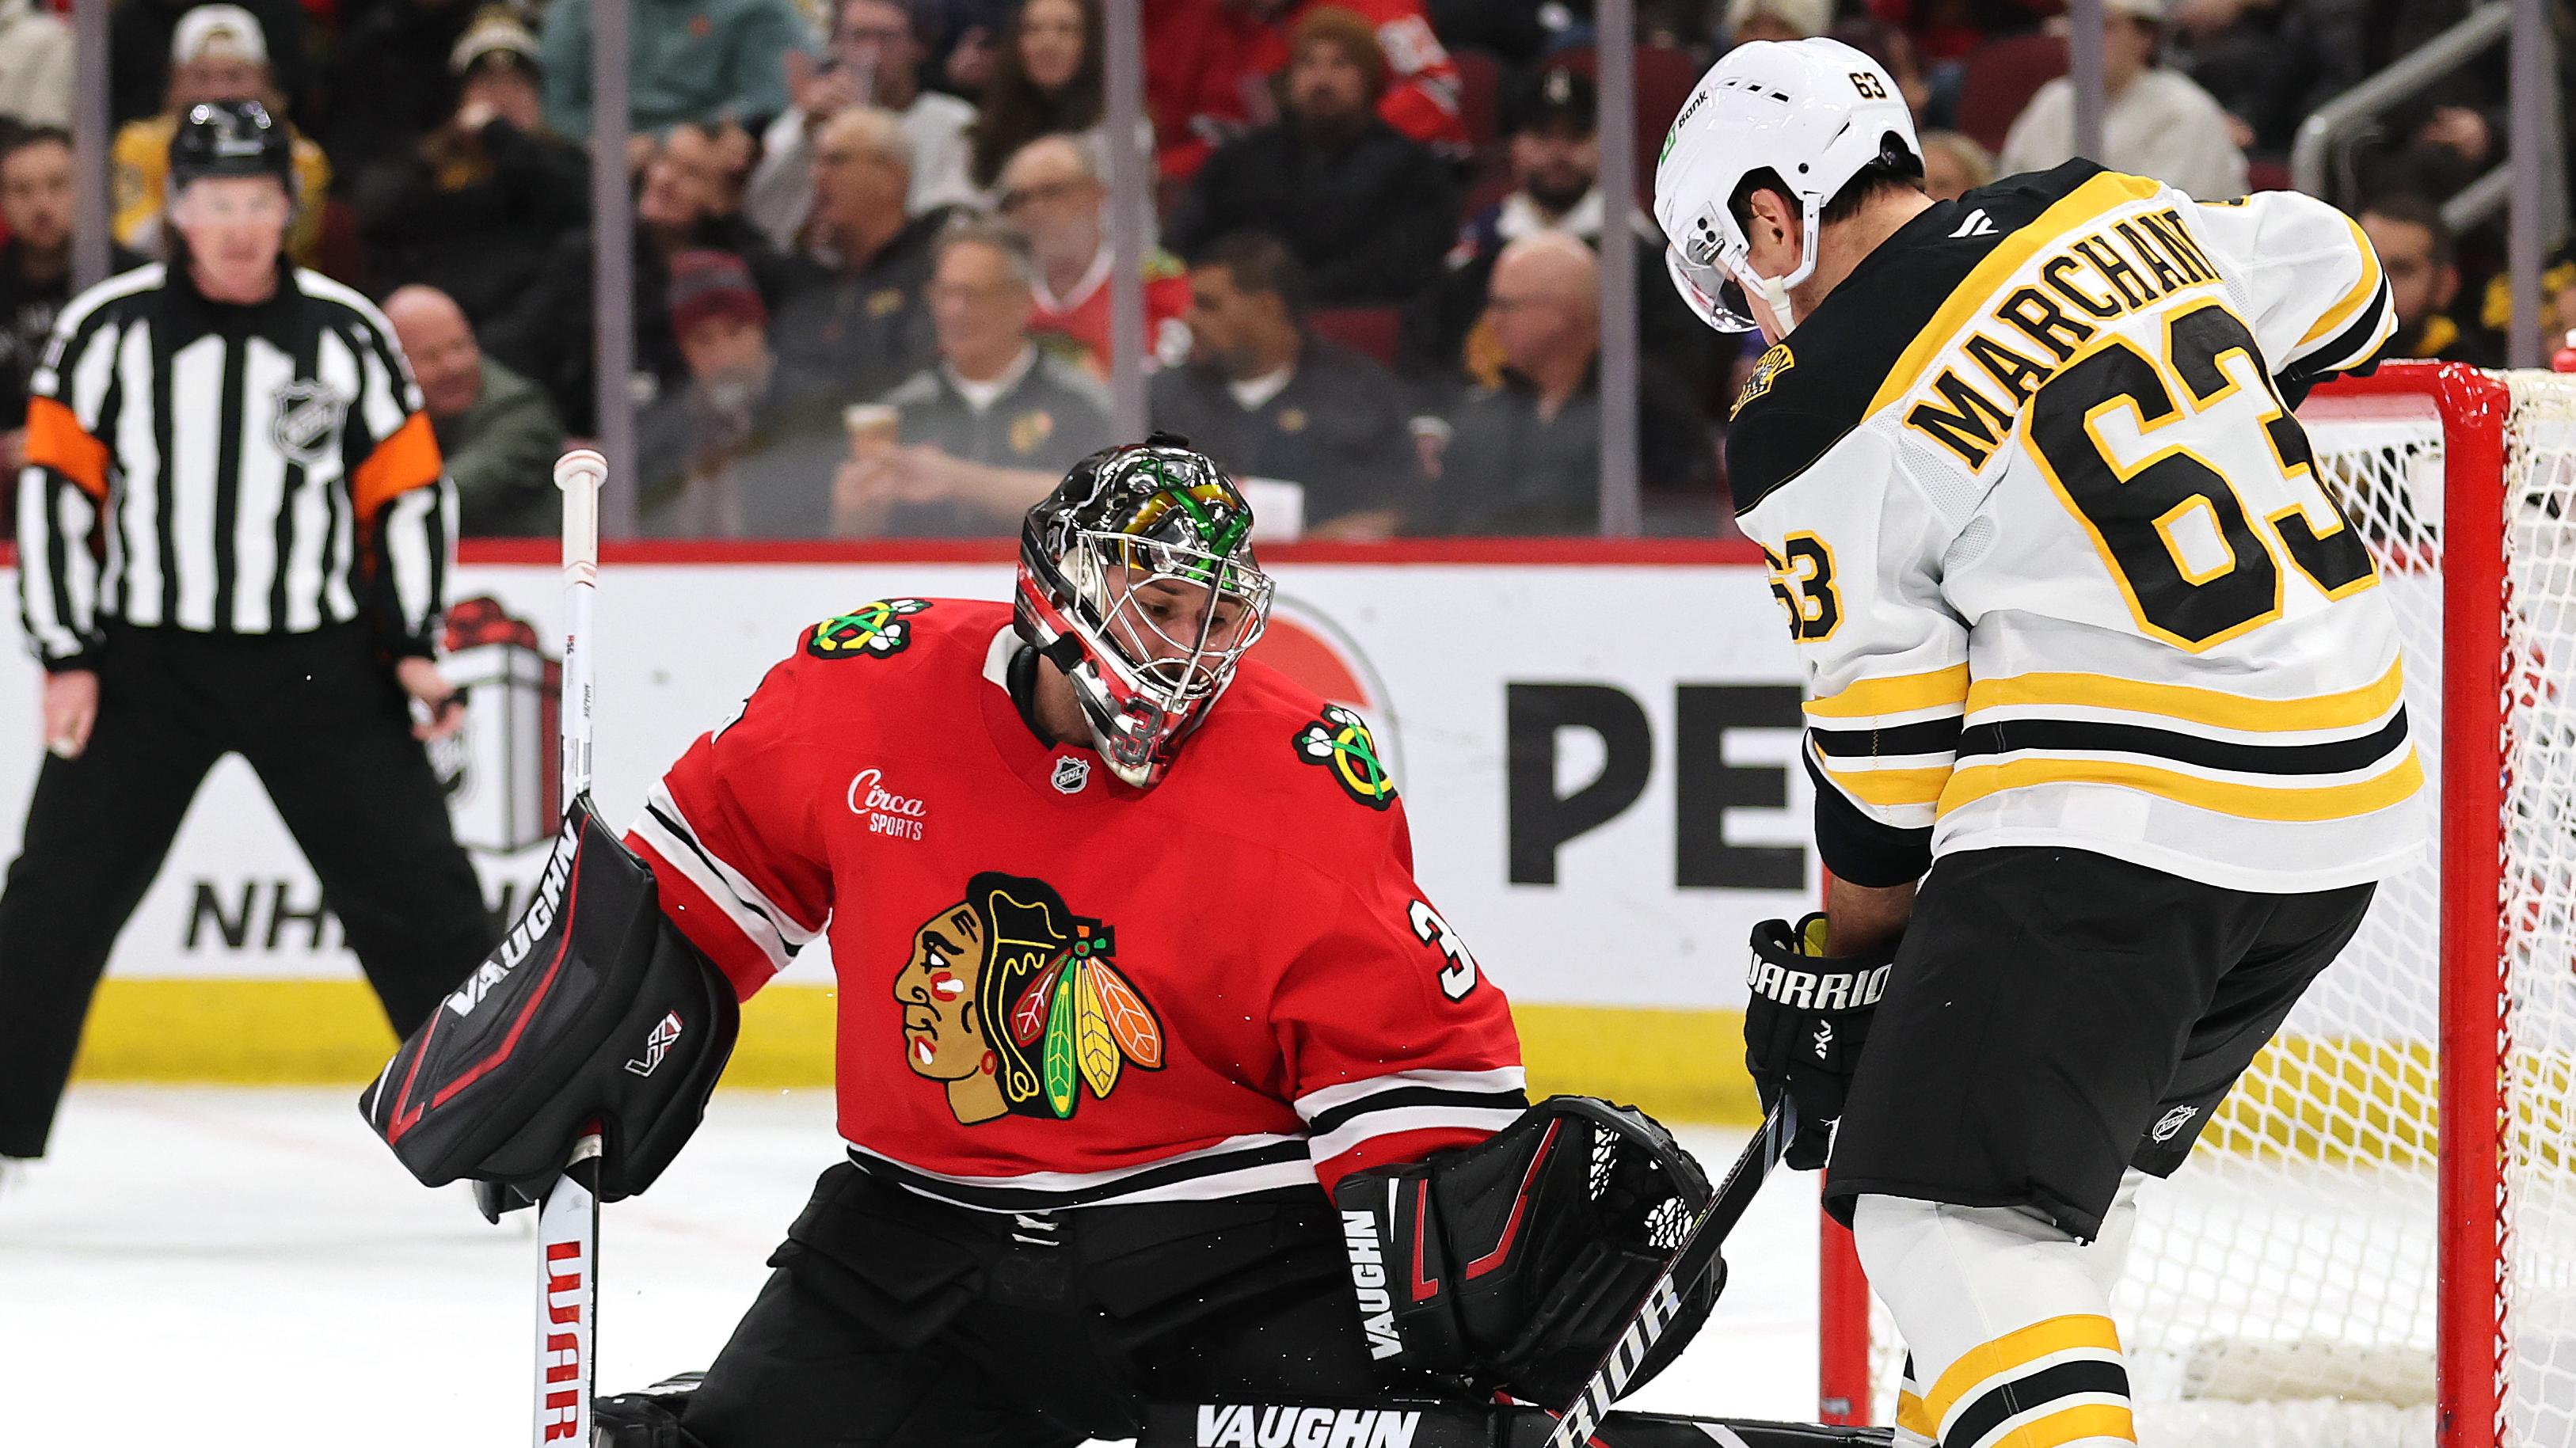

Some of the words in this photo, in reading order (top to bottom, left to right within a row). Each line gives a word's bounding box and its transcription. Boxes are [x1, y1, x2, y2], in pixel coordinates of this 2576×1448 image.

[1678, 89, 1709, 129] Bank
[1848, 72, 1888, 99] 63
[2020, 296, 2380, 654] 63
[847, 768, 927, 817] Circa
[869, 811, 924, 842] SPORTS
[185, 880, 348, 949] NH
[446, 816, 580, 1018] VAUGHN
[1341, 1210, 1404, 1361] VAUGHN
[1196, 1404, 1422, 1448] VAUGHN
